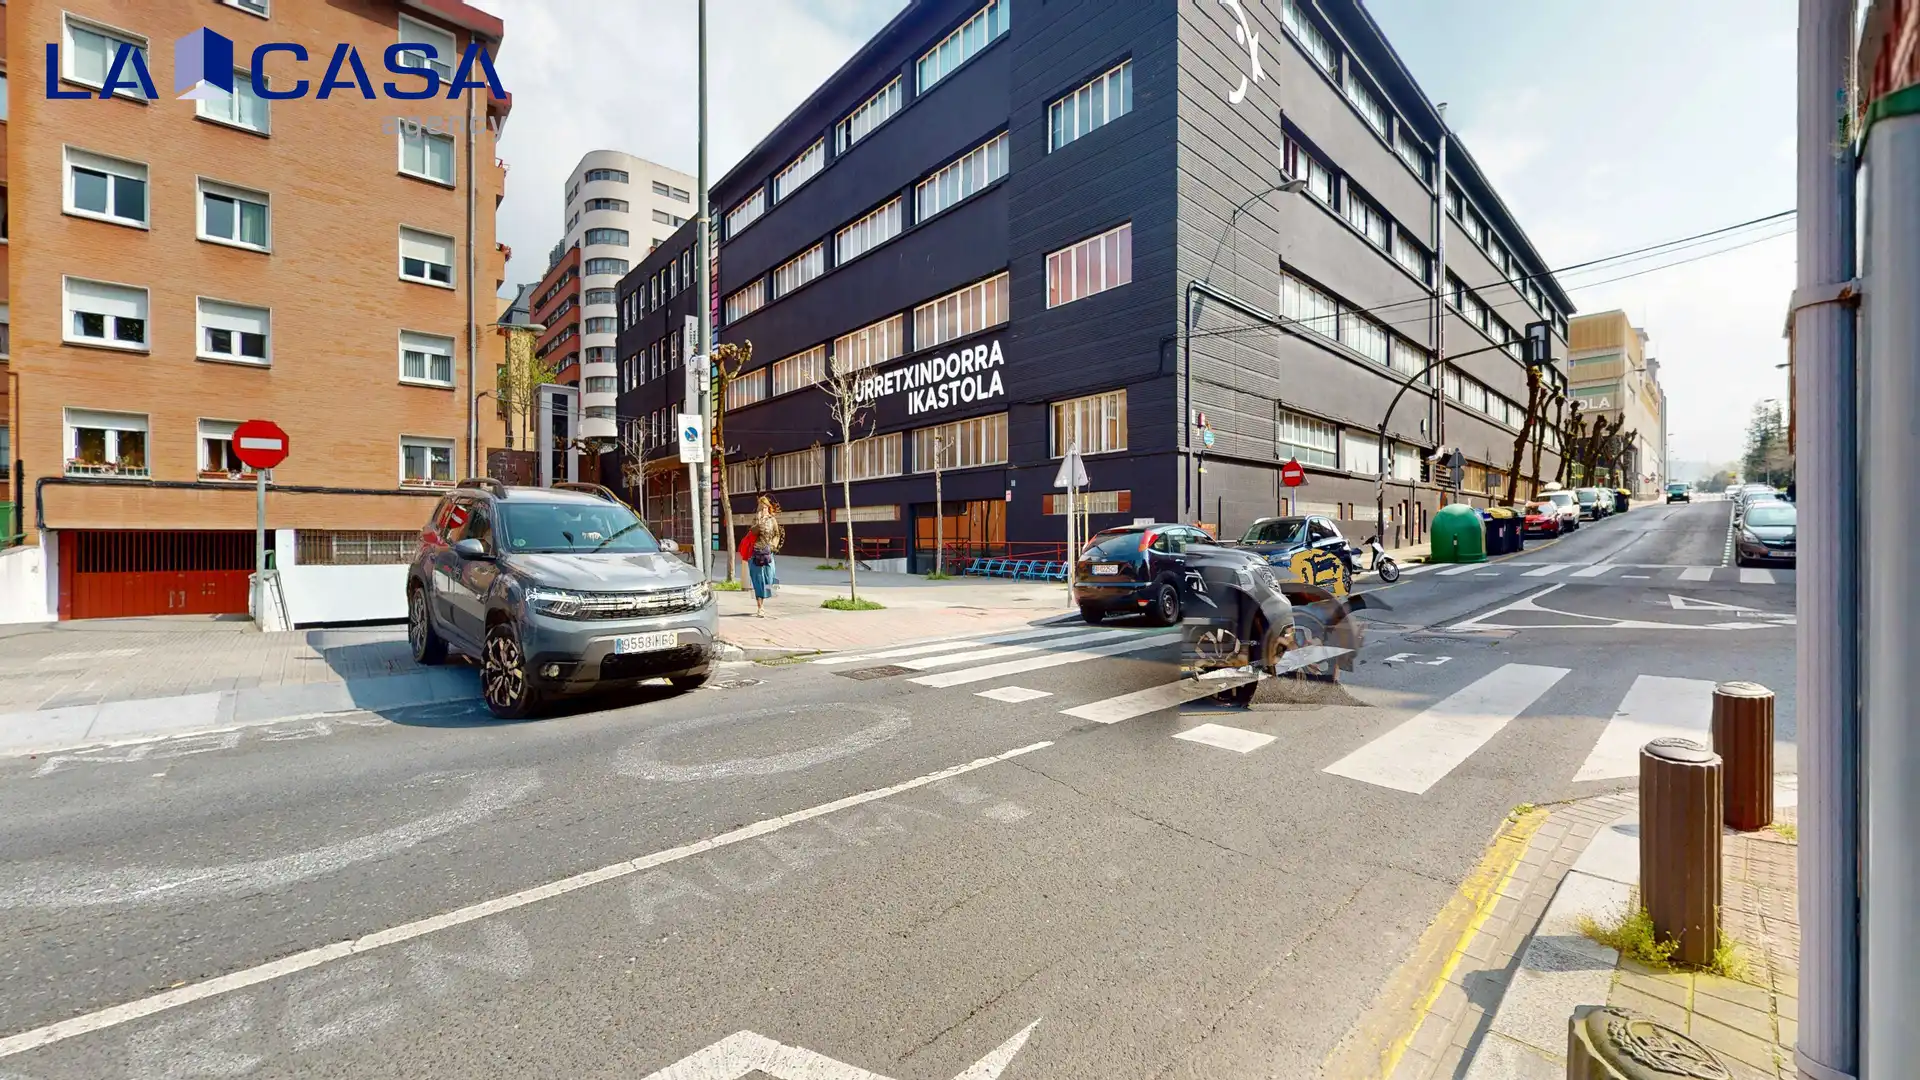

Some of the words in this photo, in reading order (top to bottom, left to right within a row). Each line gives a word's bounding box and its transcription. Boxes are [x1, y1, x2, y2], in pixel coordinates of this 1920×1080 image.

[855, 340, 1004, 402] URRETXINDORRA
[908, 370, 1004, 415] IKASTOLA
[1568, 397, 1610, 412] OLA
